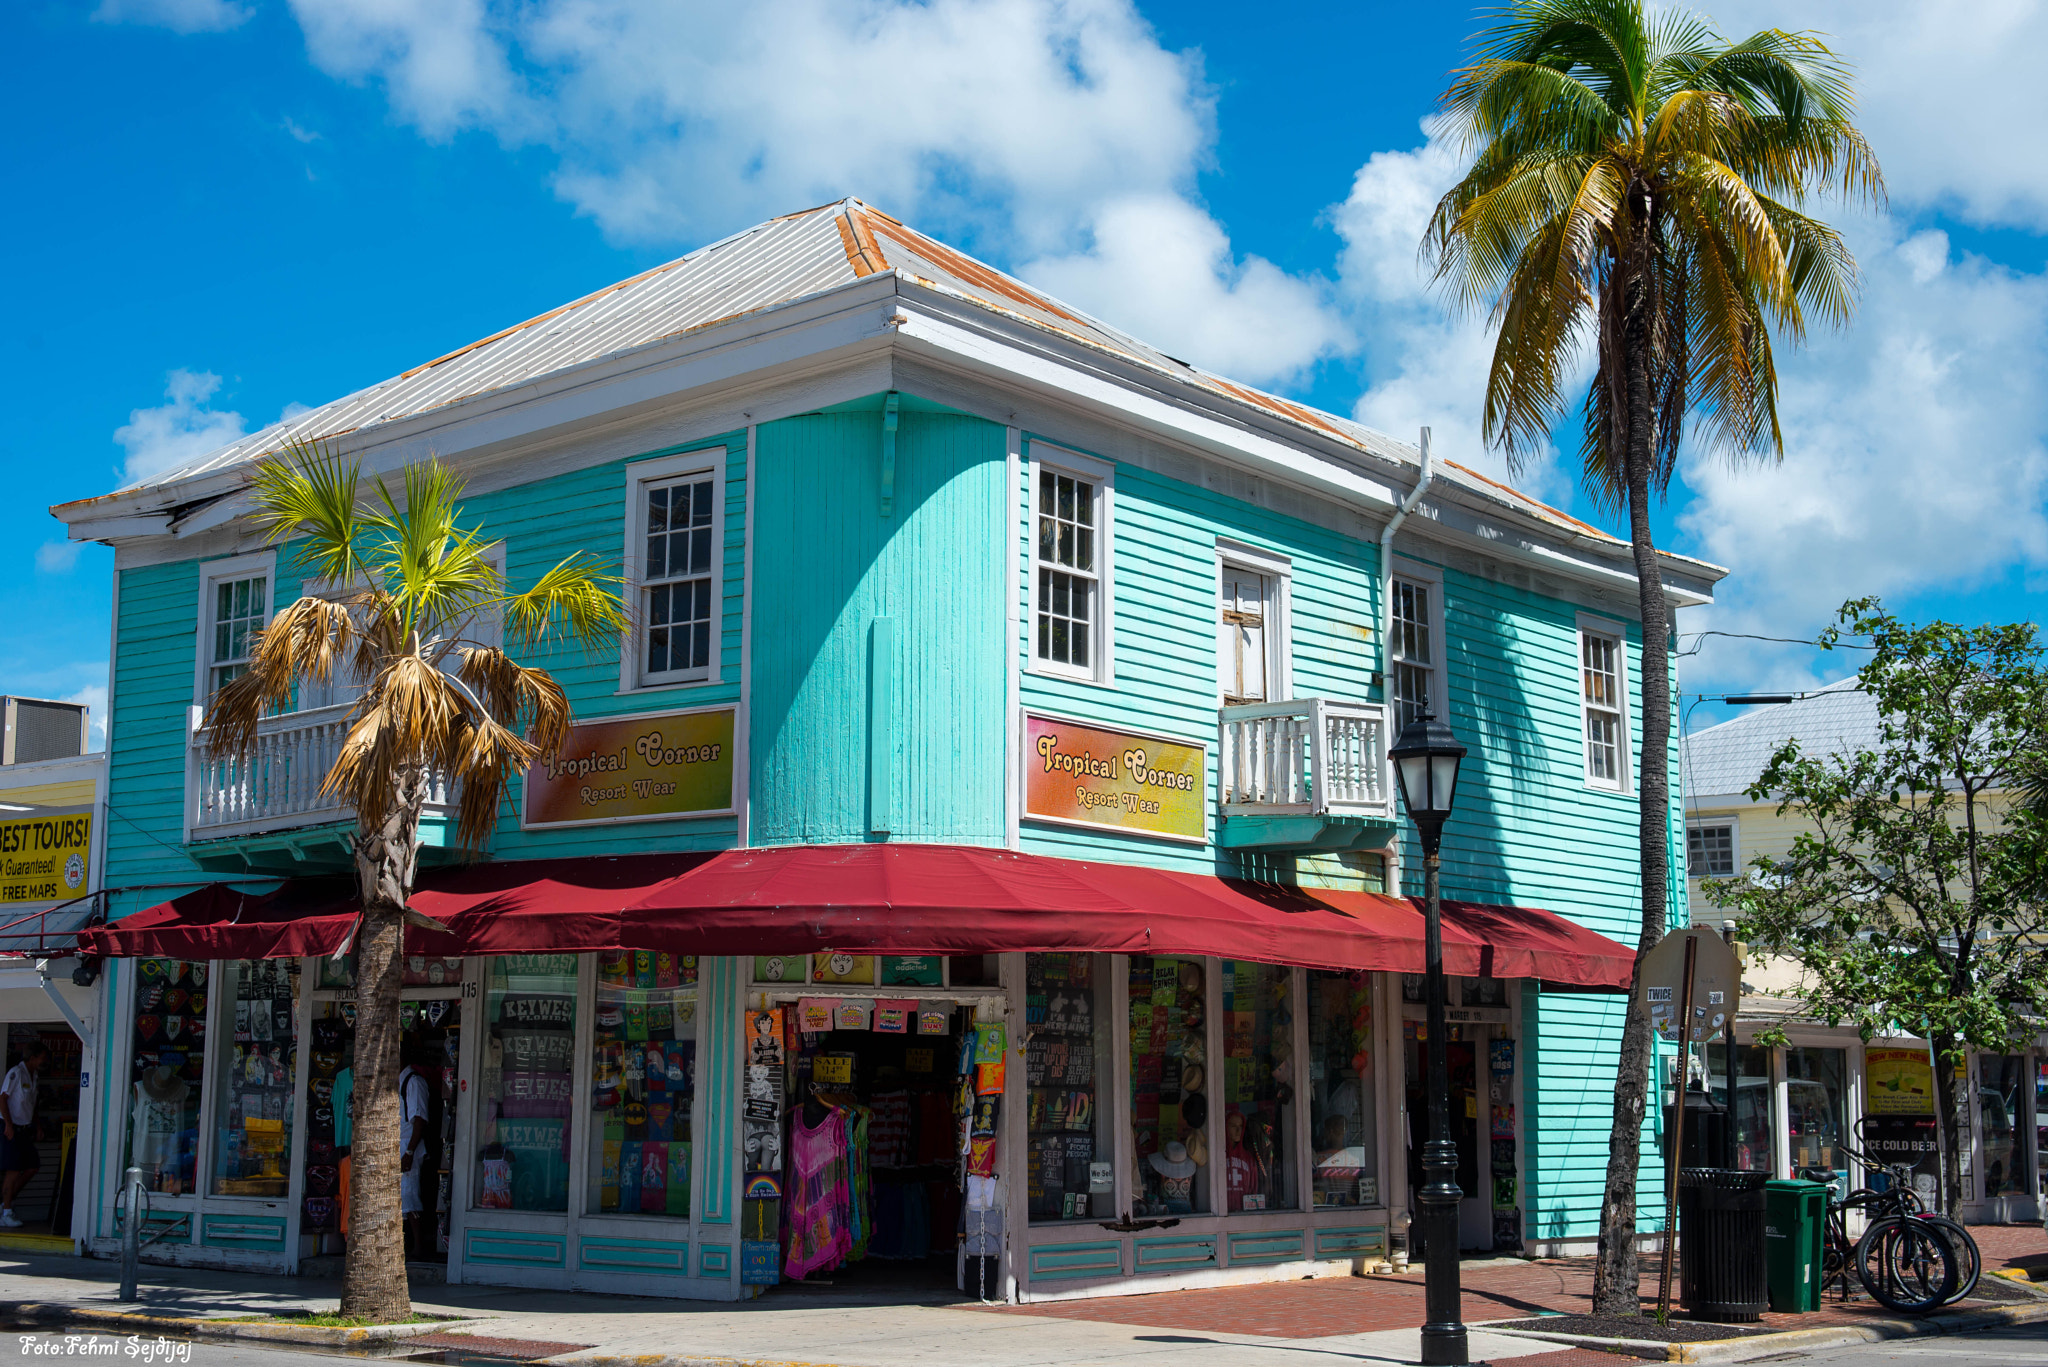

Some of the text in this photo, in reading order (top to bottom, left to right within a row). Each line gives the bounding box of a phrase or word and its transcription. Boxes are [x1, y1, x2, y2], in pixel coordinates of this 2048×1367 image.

[541, 731, 721, 780] Tropical Corner
[1037, 735, 1193, 791] Tropical Corner
[580, 779, 676, 806] Resort Wear
[1076, 785, 1159, 814] Resort Wear
[33, 819, 89, 850] TOURS!
[5, 855, 57, 876] Guaranteed!
[3, 883, 58, 900] FREE MAPS
[505, 954, 535, 970] KEY
[839, 964, 845, 973] 3
[895, 963, 928, 971] addicted
[1155, 966, 1175, 978] RELAX
[461, 982, 477, 998] 115
[1648, 988, 1672, 1000] TWICE
[504, 999, 572, 1019] KEY WES
[42, 1039, 82, 1051] BUY TIC
[502, 1036, 533, 1053] KEY
[815, 1057, 850, 1066] SALE
[1492, 1061, 1512, 1070] BOSS
[1868, 1051, 1929, 1064] NEW NEW NEW
[1027, 1072, 1044, 1081] HIRT
[503, 1079, 570, 1096] KEY WES
[500, 1126, 563, 1143] KEY WES
[1864, 1140, 1937, 1152] ICE COLD BEER
